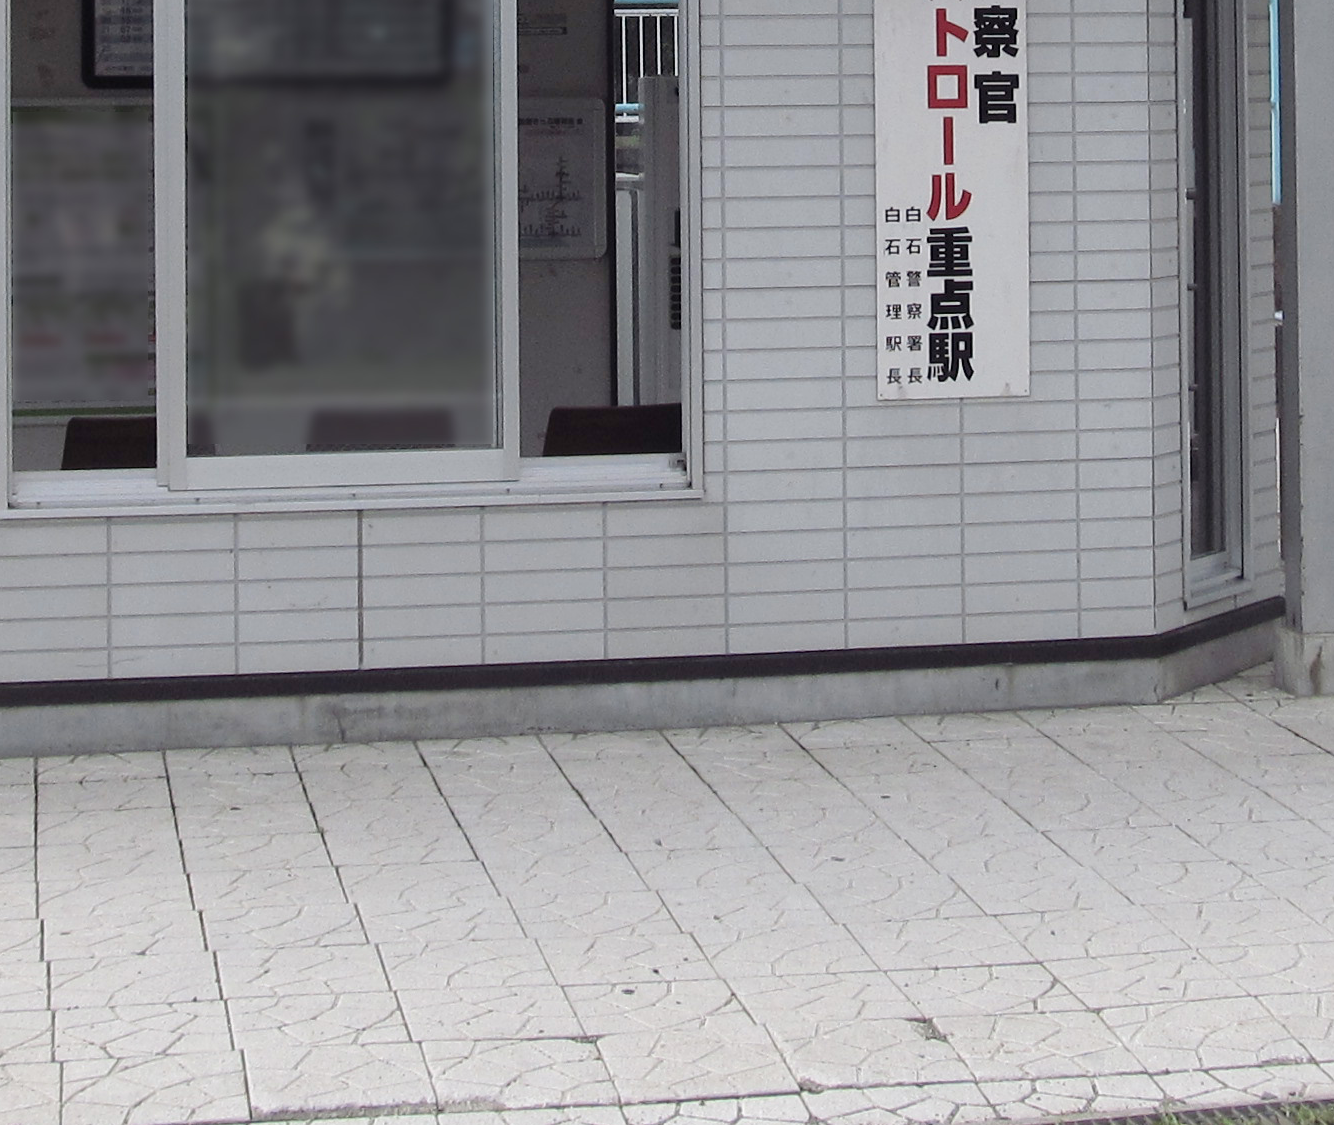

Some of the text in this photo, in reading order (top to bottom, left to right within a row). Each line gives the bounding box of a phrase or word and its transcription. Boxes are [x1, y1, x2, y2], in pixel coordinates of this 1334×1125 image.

[884, 206, 903, 386] 白石管理駅長
[905, 205, 923, 385] 白石警察署長
